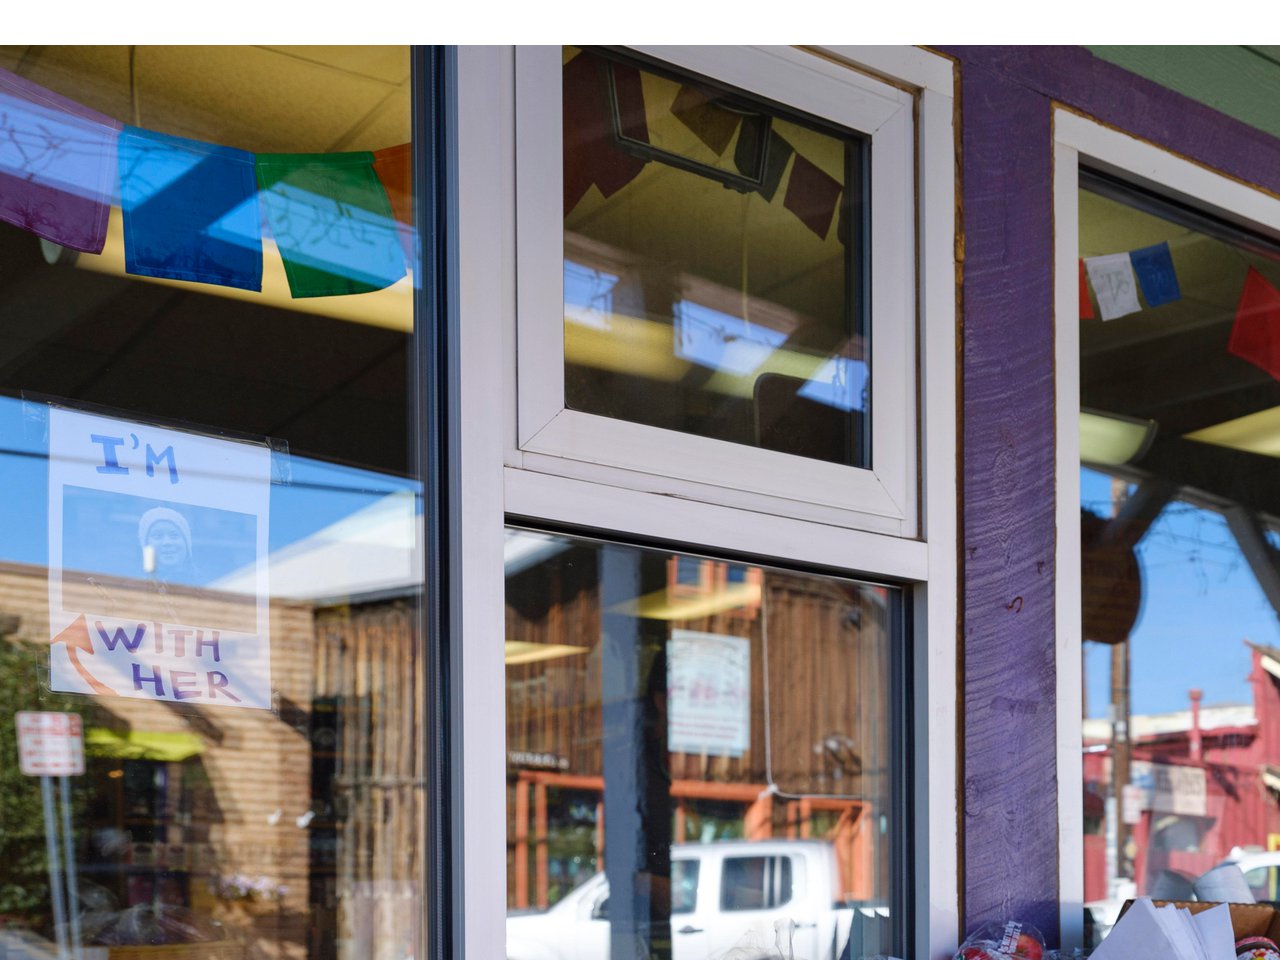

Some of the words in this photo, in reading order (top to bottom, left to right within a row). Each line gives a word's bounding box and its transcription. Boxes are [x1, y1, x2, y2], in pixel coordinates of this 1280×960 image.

[90, 432, 180, 485] I'M
[95, 620, 221, 662] WITH
[132, 663, 242, 703] HER
